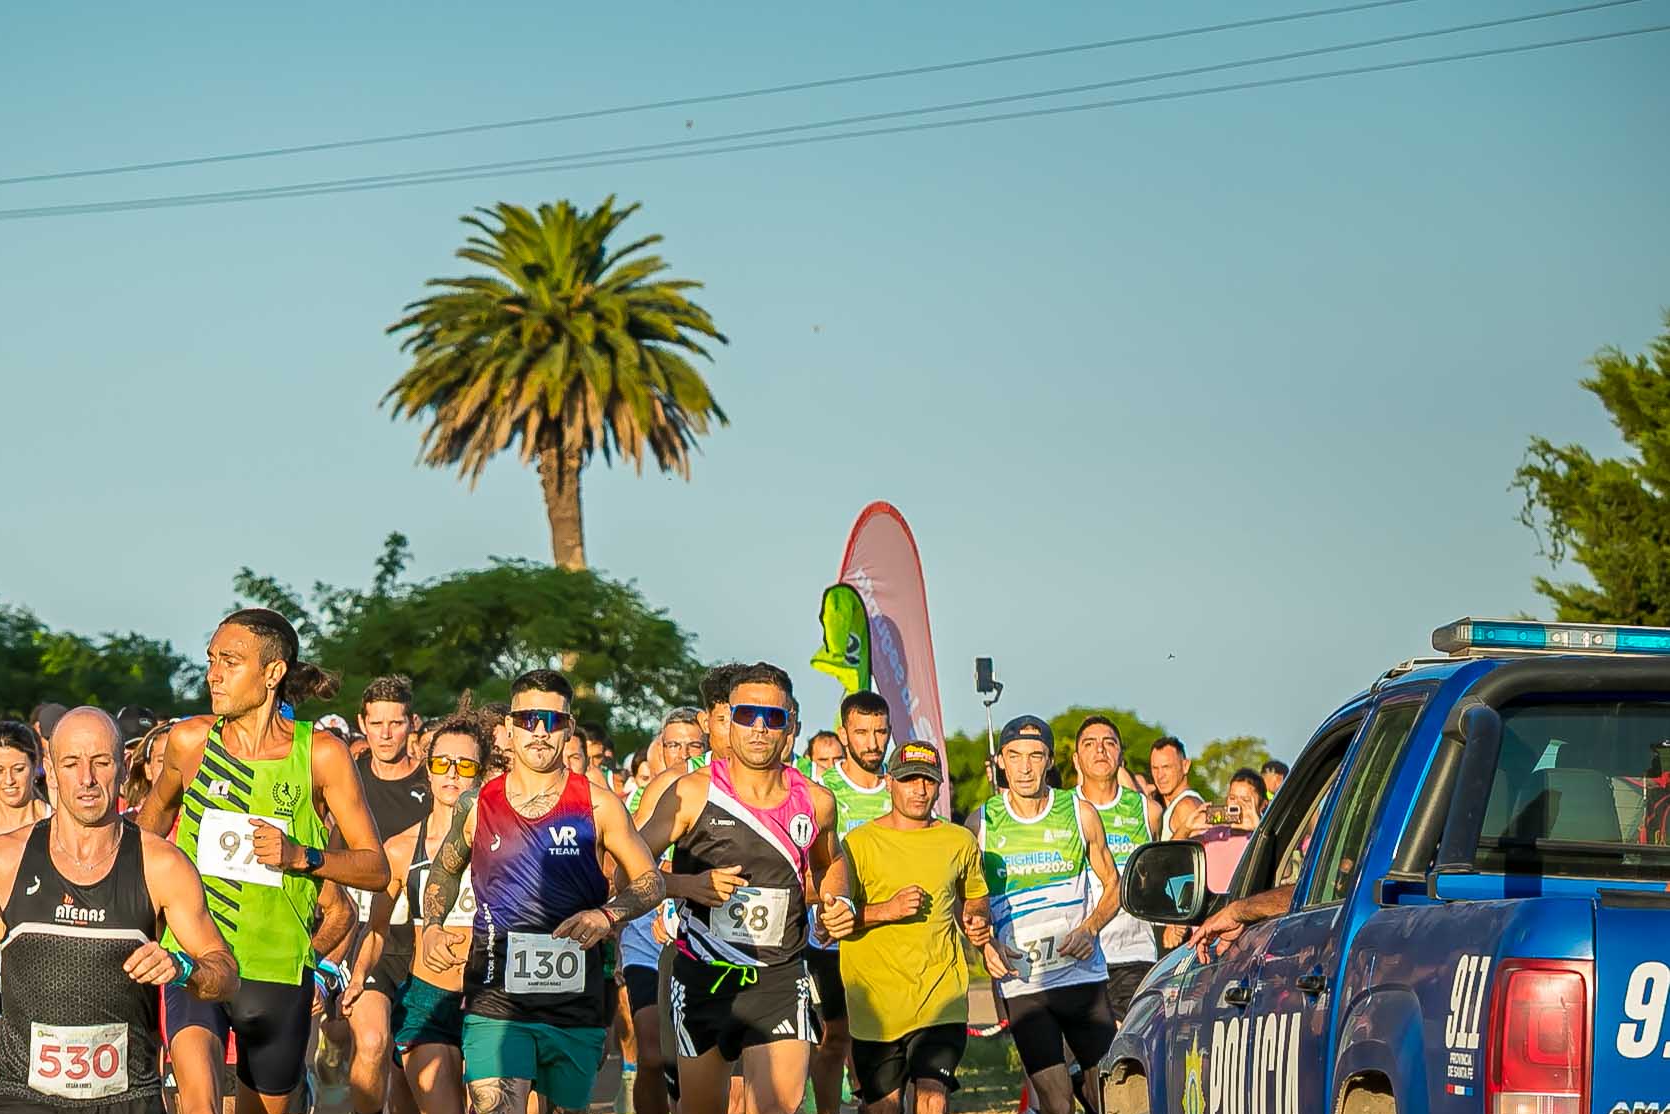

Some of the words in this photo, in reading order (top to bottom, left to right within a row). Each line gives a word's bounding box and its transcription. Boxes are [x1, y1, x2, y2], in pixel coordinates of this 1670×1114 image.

[548, 826, 578, 846] VR
[548, 847, 580, 856] TEAM
[1003, 851, 1063, 865] FIGHIERA
[55, 904, 106, 922] ATENAS
[451, 888, 477, 912] 6
[728, 902, 769, 931] 98
[1023, 936, 1055, 963] 37
[514, 950, 579, 979] 130
[1446, 954, 1492, 1049] 911
[1616, 961, 1670, 1060] 9
[38, 1044, 119, 1080] 530
